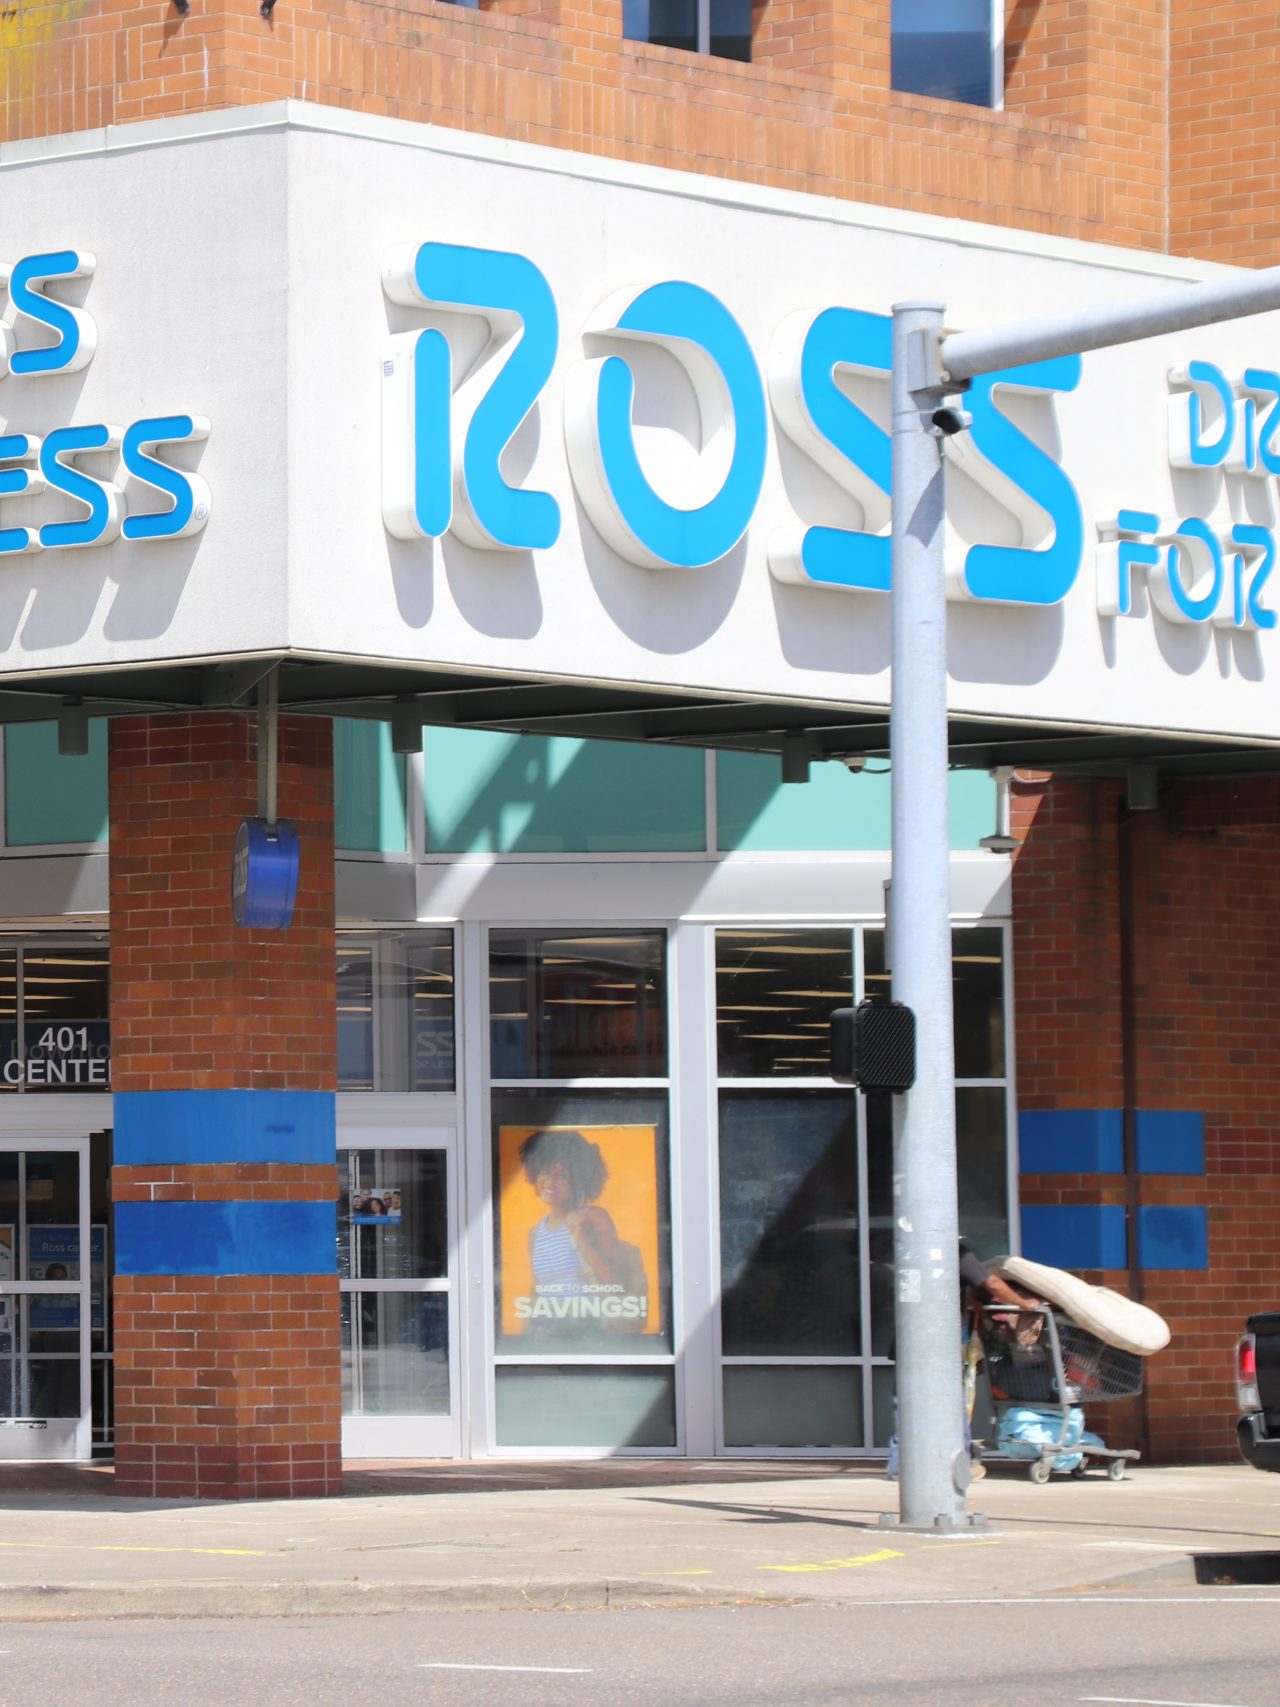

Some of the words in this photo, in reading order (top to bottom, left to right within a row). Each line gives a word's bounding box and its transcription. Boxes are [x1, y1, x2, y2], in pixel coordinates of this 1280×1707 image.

[382, 241, 1084, 605] ROSS
[1097, 508, 1277, 631] FOR
[38, 1026, 88, 1052] 401
[41, 1242, 66, 1253] Ross
[535, 1284, 563, 1294] BACK
[581, 1284, 625, 1294] SCHOOL
[513, 1295, 648, 1319] SAVINGS!
